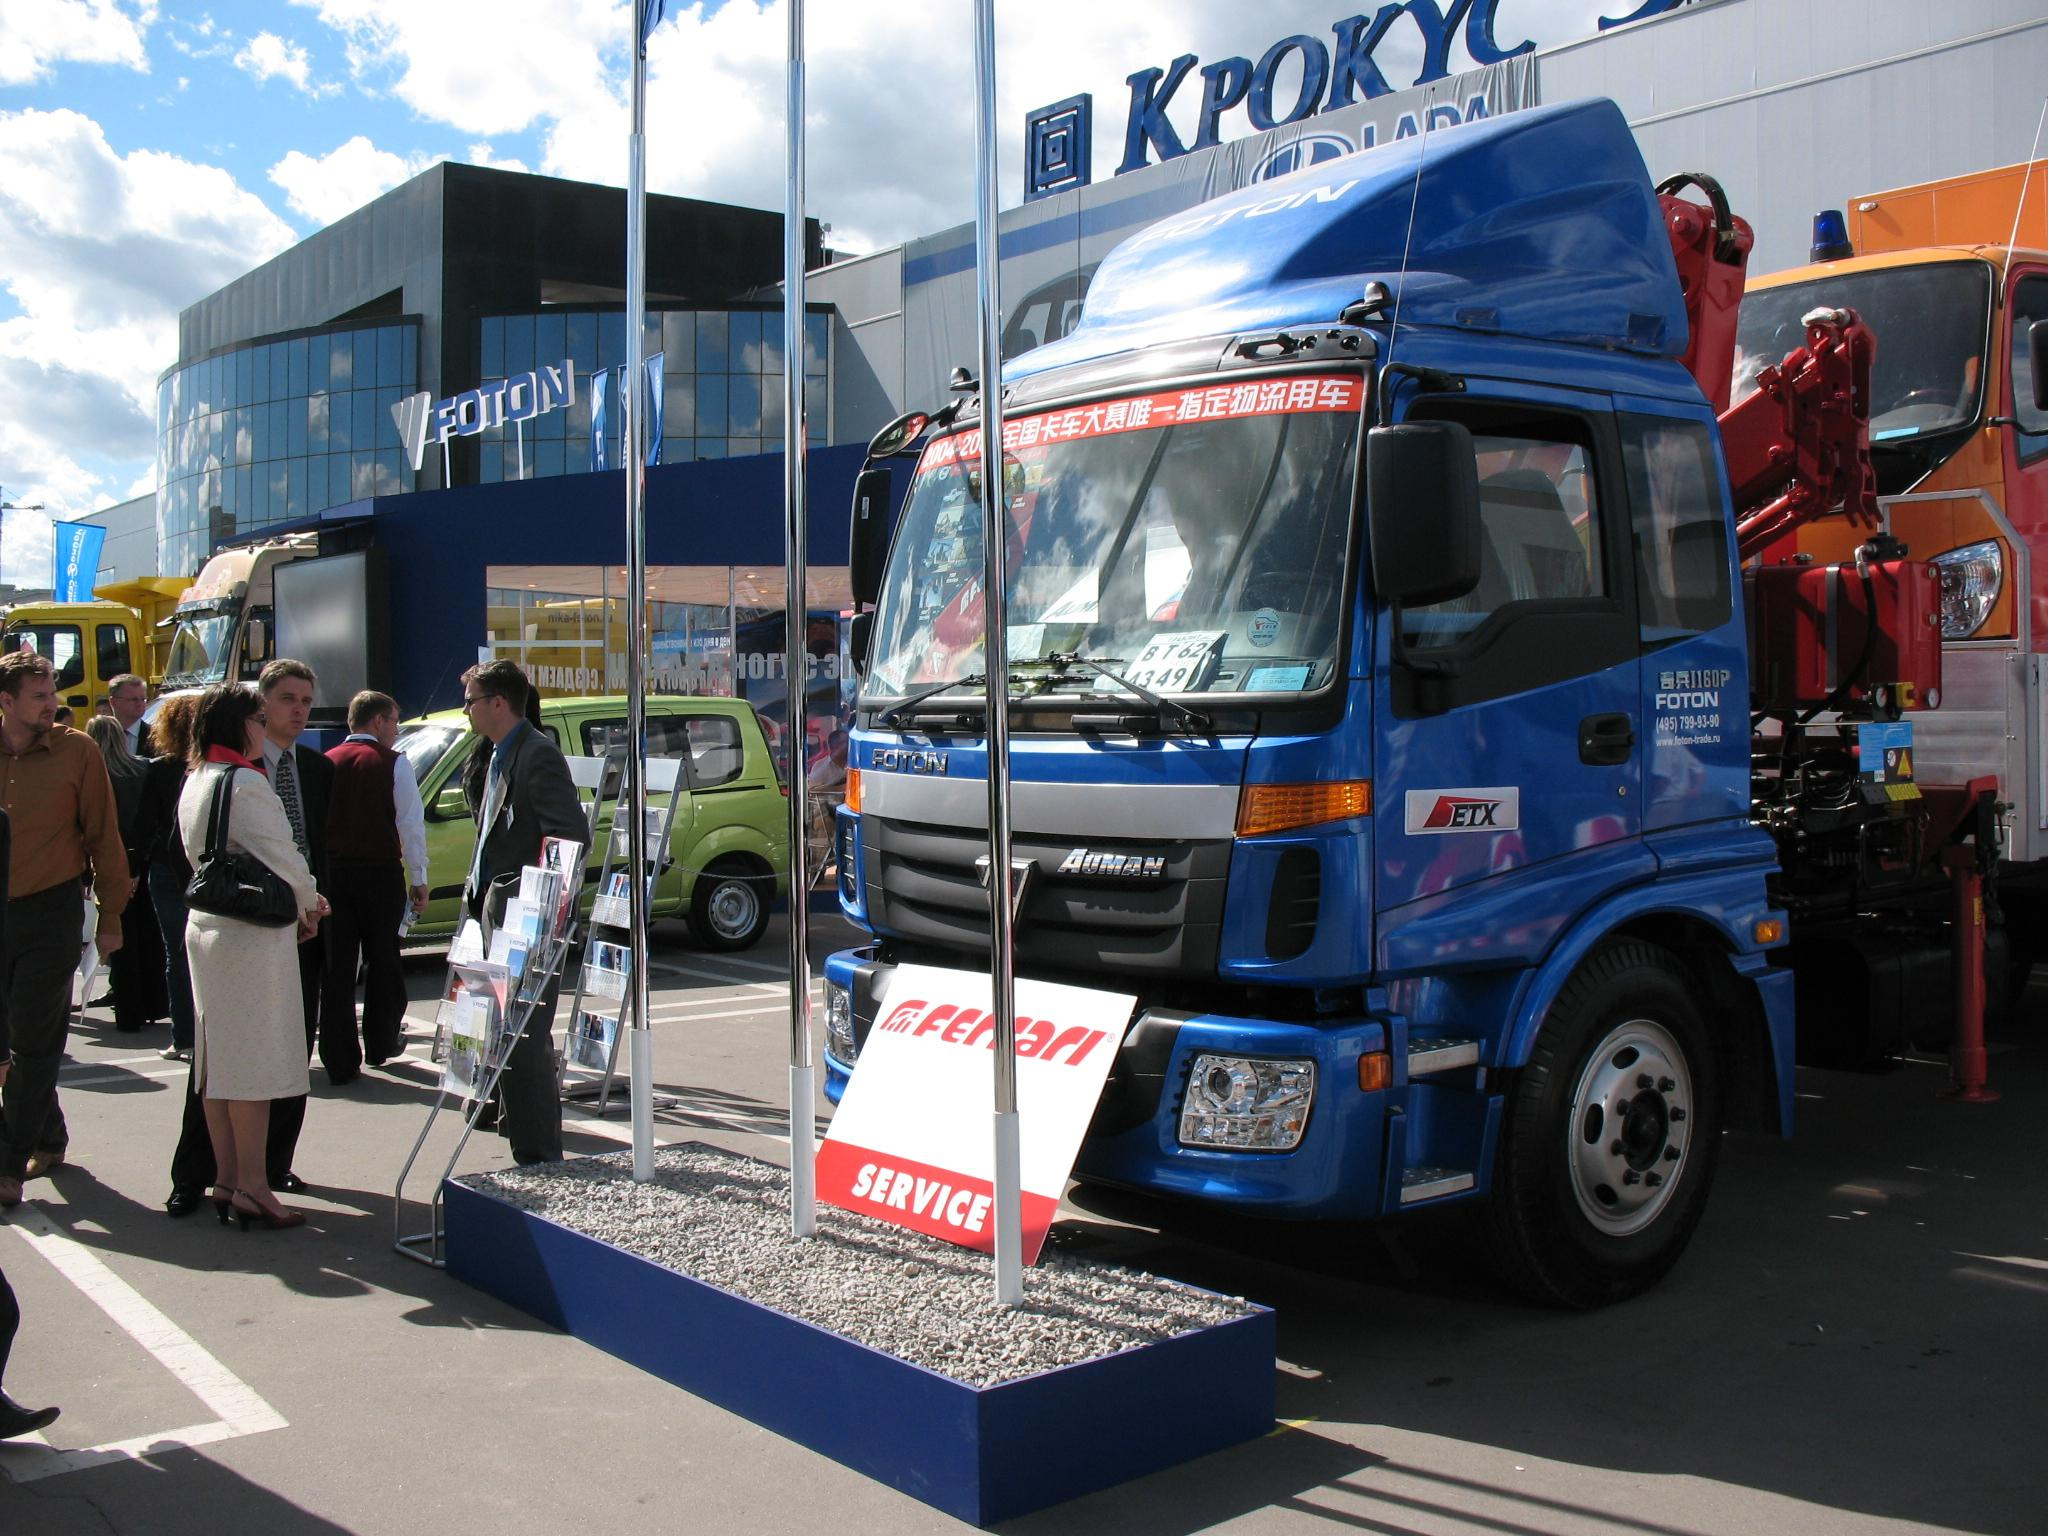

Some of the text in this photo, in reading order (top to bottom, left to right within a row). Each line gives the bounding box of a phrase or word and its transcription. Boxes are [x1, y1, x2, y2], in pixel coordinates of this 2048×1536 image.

[1115, 0, 1537, 176] КРОКУС
[1127, 179, 1361, 251] FOTON
[433, 359, 575, 444] FOTON
[1655, 691, 1719, 710] FOTON
[1656, 714, 1720, 734] (495) 799-93-90
[1656, 733, 1721, 747] www.foton-trade.ru
[872, 748, 949, 776] FOTON
[1449, 802, 1501, 828] ETX
[851, 1163, 992, 1233] SERVICE
